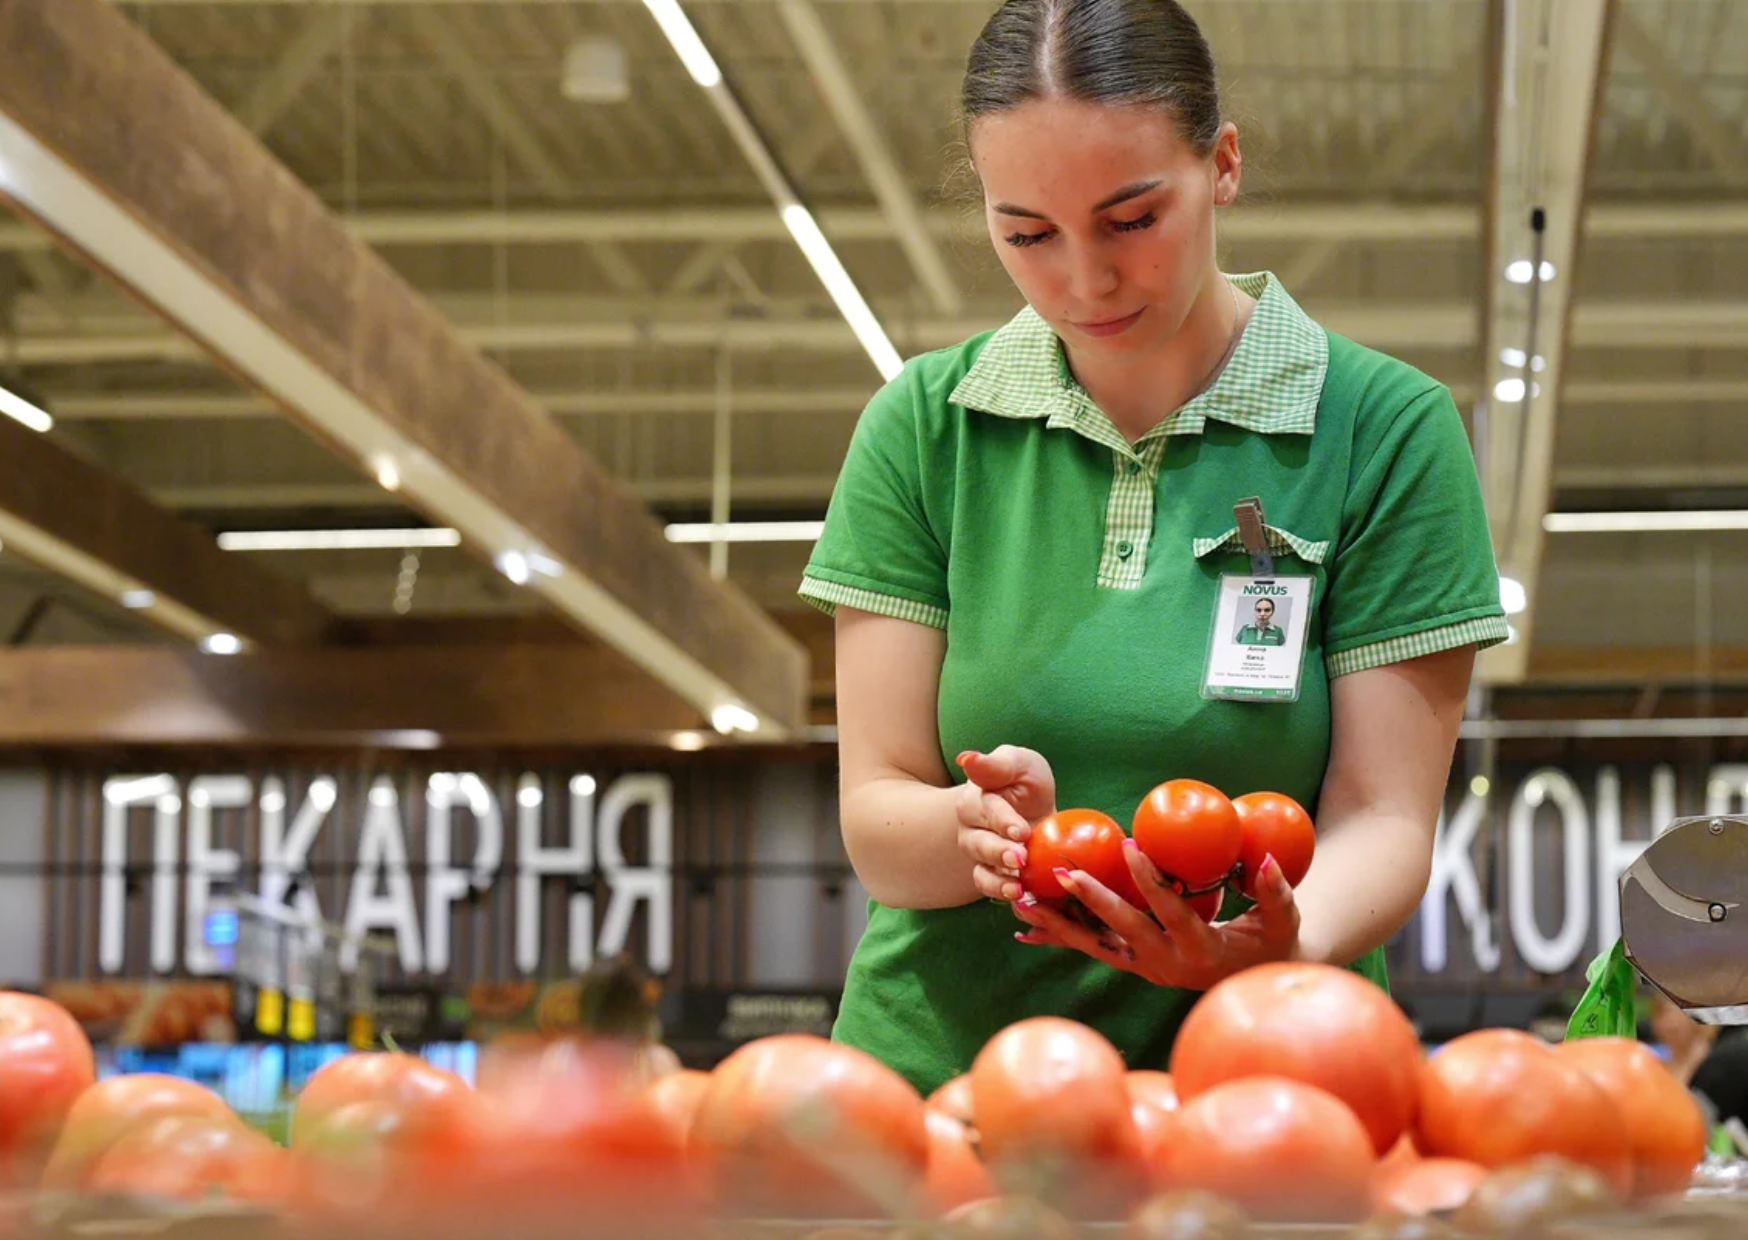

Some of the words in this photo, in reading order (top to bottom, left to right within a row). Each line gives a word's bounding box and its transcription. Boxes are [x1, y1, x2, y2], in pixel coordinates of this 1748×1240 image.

[1243, 585, 1288, 595] NOVUS
[100, 771, 674, 975] ПЕКАРНЯ
[1420, 762, 1748, 974] КОН
